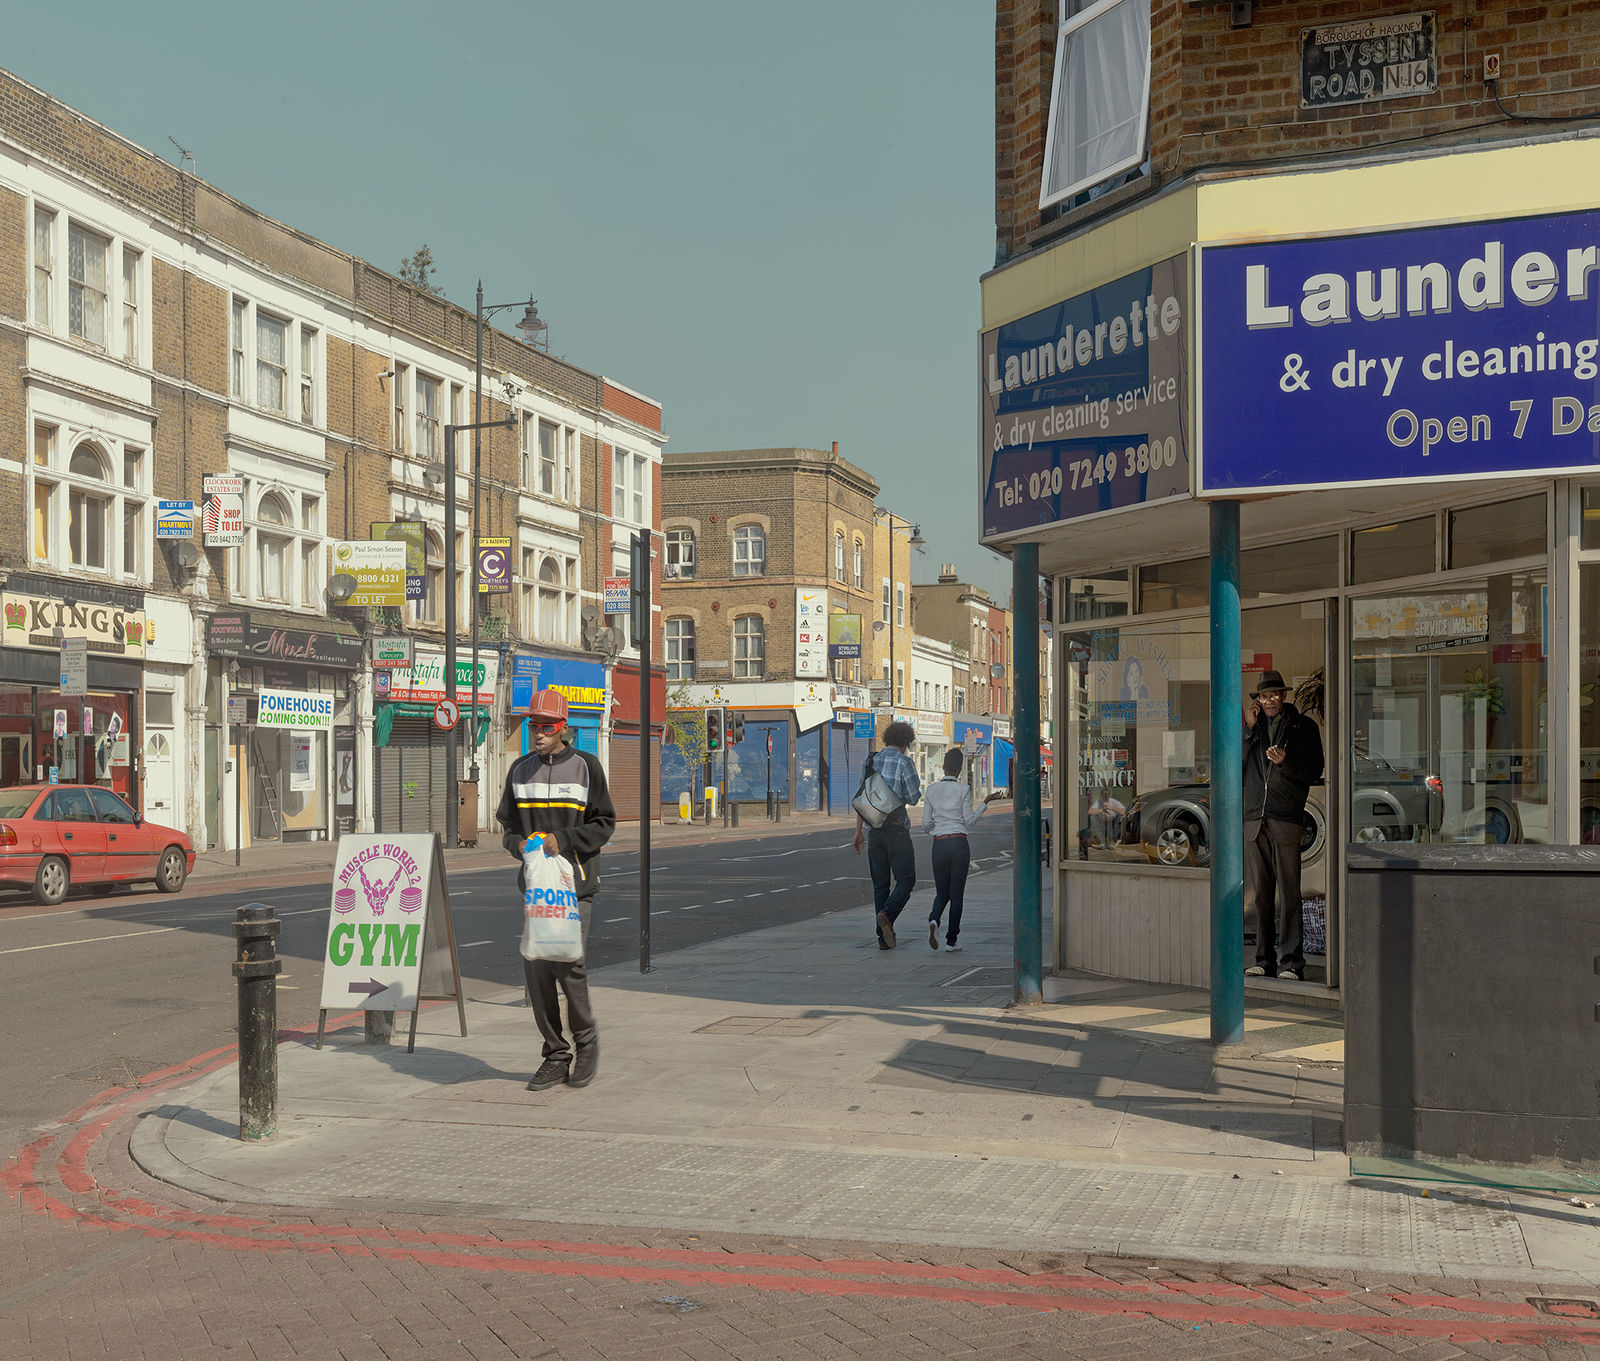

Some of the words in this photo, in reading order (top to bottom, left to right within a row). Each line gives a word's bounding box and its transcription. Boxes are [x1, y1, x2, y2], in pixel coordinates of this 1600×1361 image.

[1316, 30, 1363, 44] BOROUGH
[1364, 28, 1376, 38] OF
[1379, 21, 1421, 36] HACKNEY
[1324, 36, 1416, 70] TYSSEN
[1310, 68, 1375, 100] ROAD
[988, 294, 1182, 396] Launderette
[1280, 353, 1310, 392] &
[1332, 350, 1404, 396] dry
[1422, 332, 1599, 380] cleaning
[993, 422, 1004, 452] &
[1010, 416, 1036, 451] dry
[1042, 394, 1110, 437] cleaning
[1116, 375, 1176, 416] service
[1386, 409, 1492, 456] Open
[1510, 398, 1534, 439] 7
[995, 477, 1023, 508] Tel:
[1029, 469, 1062, 500] 020
[1070, 452, 1118, 491] 7249
[1124, 436, 1176, 478] 3800
[221, 521, 230, 532] TO
[232, 521, 242, 531] LET
[224, 509, 240, 518] SHOP
[355, 596, 368, 604] TO
[372, 596, 386, 604] LET
[29, 600, 124, 642] KINGS
[1414, 620, 1448, 638] SERVICE
[1452, 614, 1488, 633] WASHES
[377, 638, 406, 648] Mostafa
[393, 656, 440, 686] Mostafa
[260, 712, 296, 724] COMING
[298, 714, 330, 726] SOON!!!
[261, 696, 331, 714] FONEHOUSE
[1077, 749, 1118, 767] SHIRT
[1079, 770, 1135, 788] SERVICE
[338, 845, 379, 884] MUSCLE
[383, 844, 418, 875] WORKS
[411, 876, 422, 885] 2
[329, 922, 420, 967] GYM
